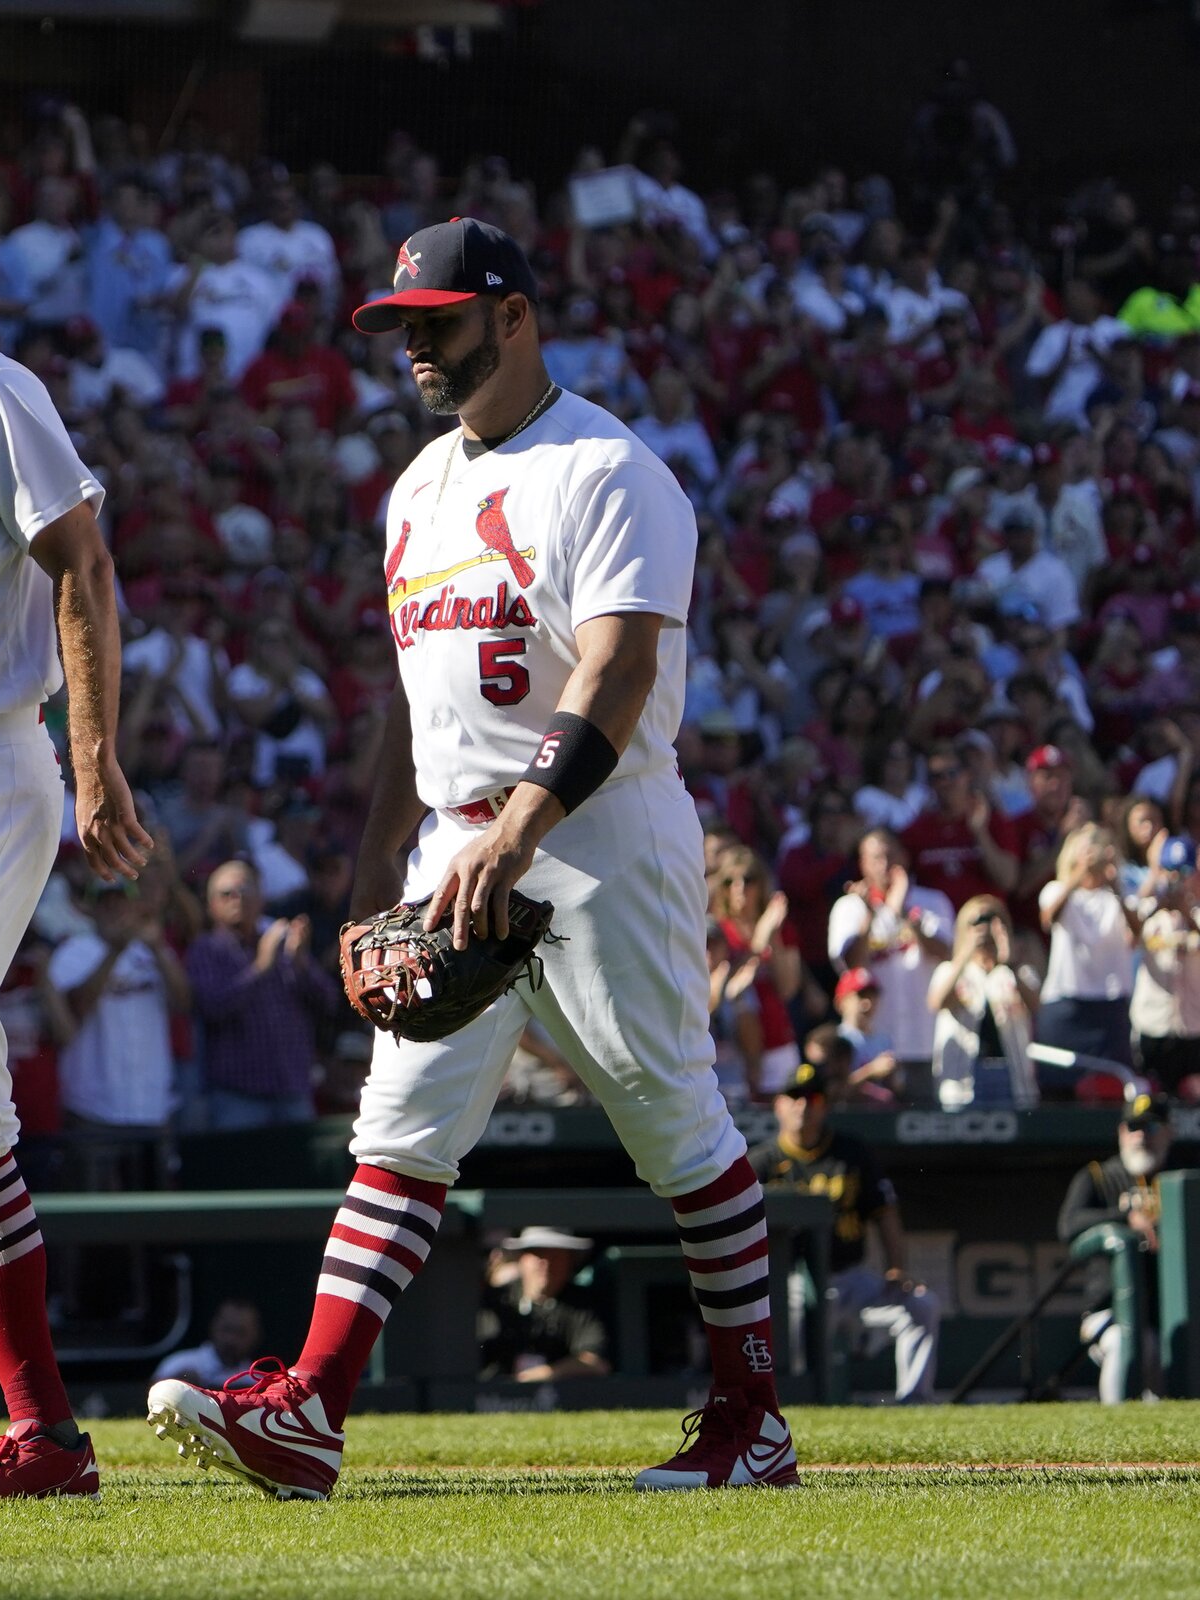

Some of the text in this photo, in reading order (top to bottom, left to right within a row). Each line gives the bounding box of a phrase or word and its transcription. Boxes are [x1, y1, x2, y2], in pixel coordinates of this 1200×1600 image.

[478, 638, 531, 706] 5
[536, 740, 560, 769] 5
[896, 1110, 1018, 1143] GEICO
